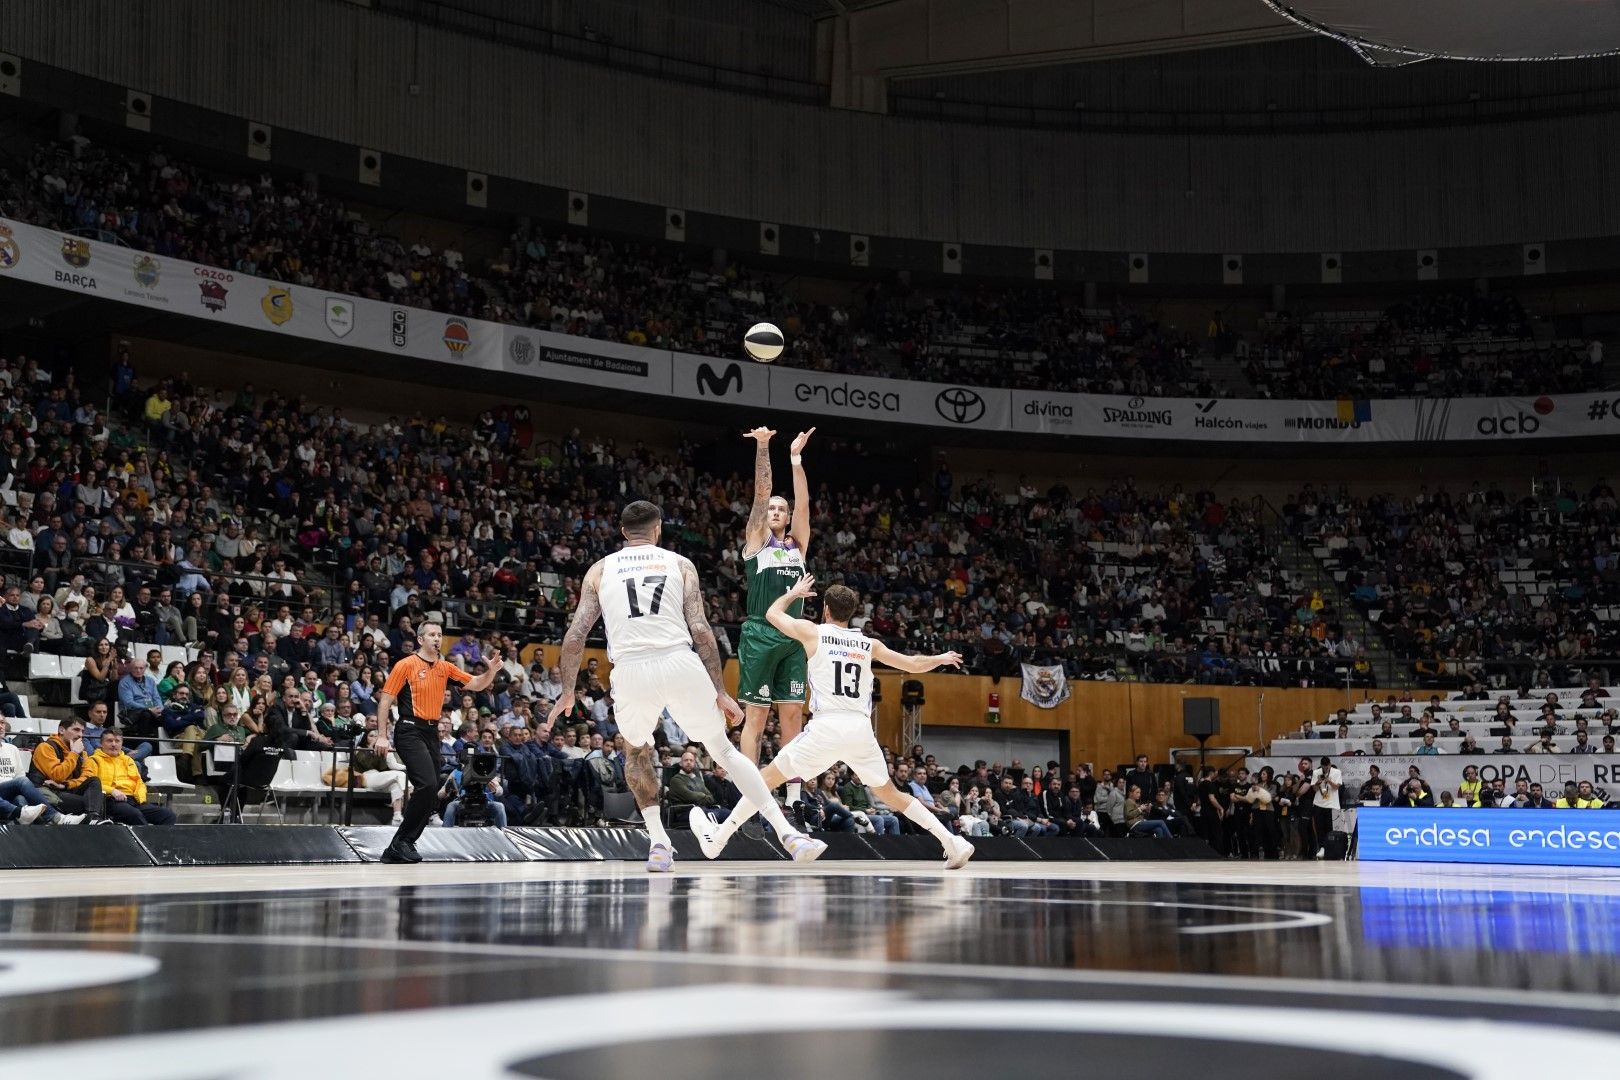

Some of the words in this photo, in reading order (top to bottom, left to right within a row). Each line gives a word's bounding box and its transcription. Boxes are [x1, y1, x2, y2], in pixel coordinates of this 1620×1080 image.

[55, 270, 97, 289] BARÇA
[193, 267, 235, 283] CAZOO
[545, 351, 592, 367] Ajuntament
[594, 358, 603, 367] de
[605, 360, 642, 373] Badalona
[795, 382, 900, 412] endesa
[1024, 400, 1073, 417] divina
[1103, 407, 1172, 426] SPALDING
[1195, 414, 1243, 429] Halcón
[1245, 421, 1268, 430] viajes
[1477, 411, 1540, 435] acb
[617, 564, 667, 574] AUTOHERO
[622, 575, 668, 619] 17
[828, 650, 866, 660] AUTOHERO
[832, 660, 862, 698] 13
[1539, 764, 1577, 784] DEL
[1385, 823, 1490, 847] endesa
[1508, 825, 1620, 849] endesa
